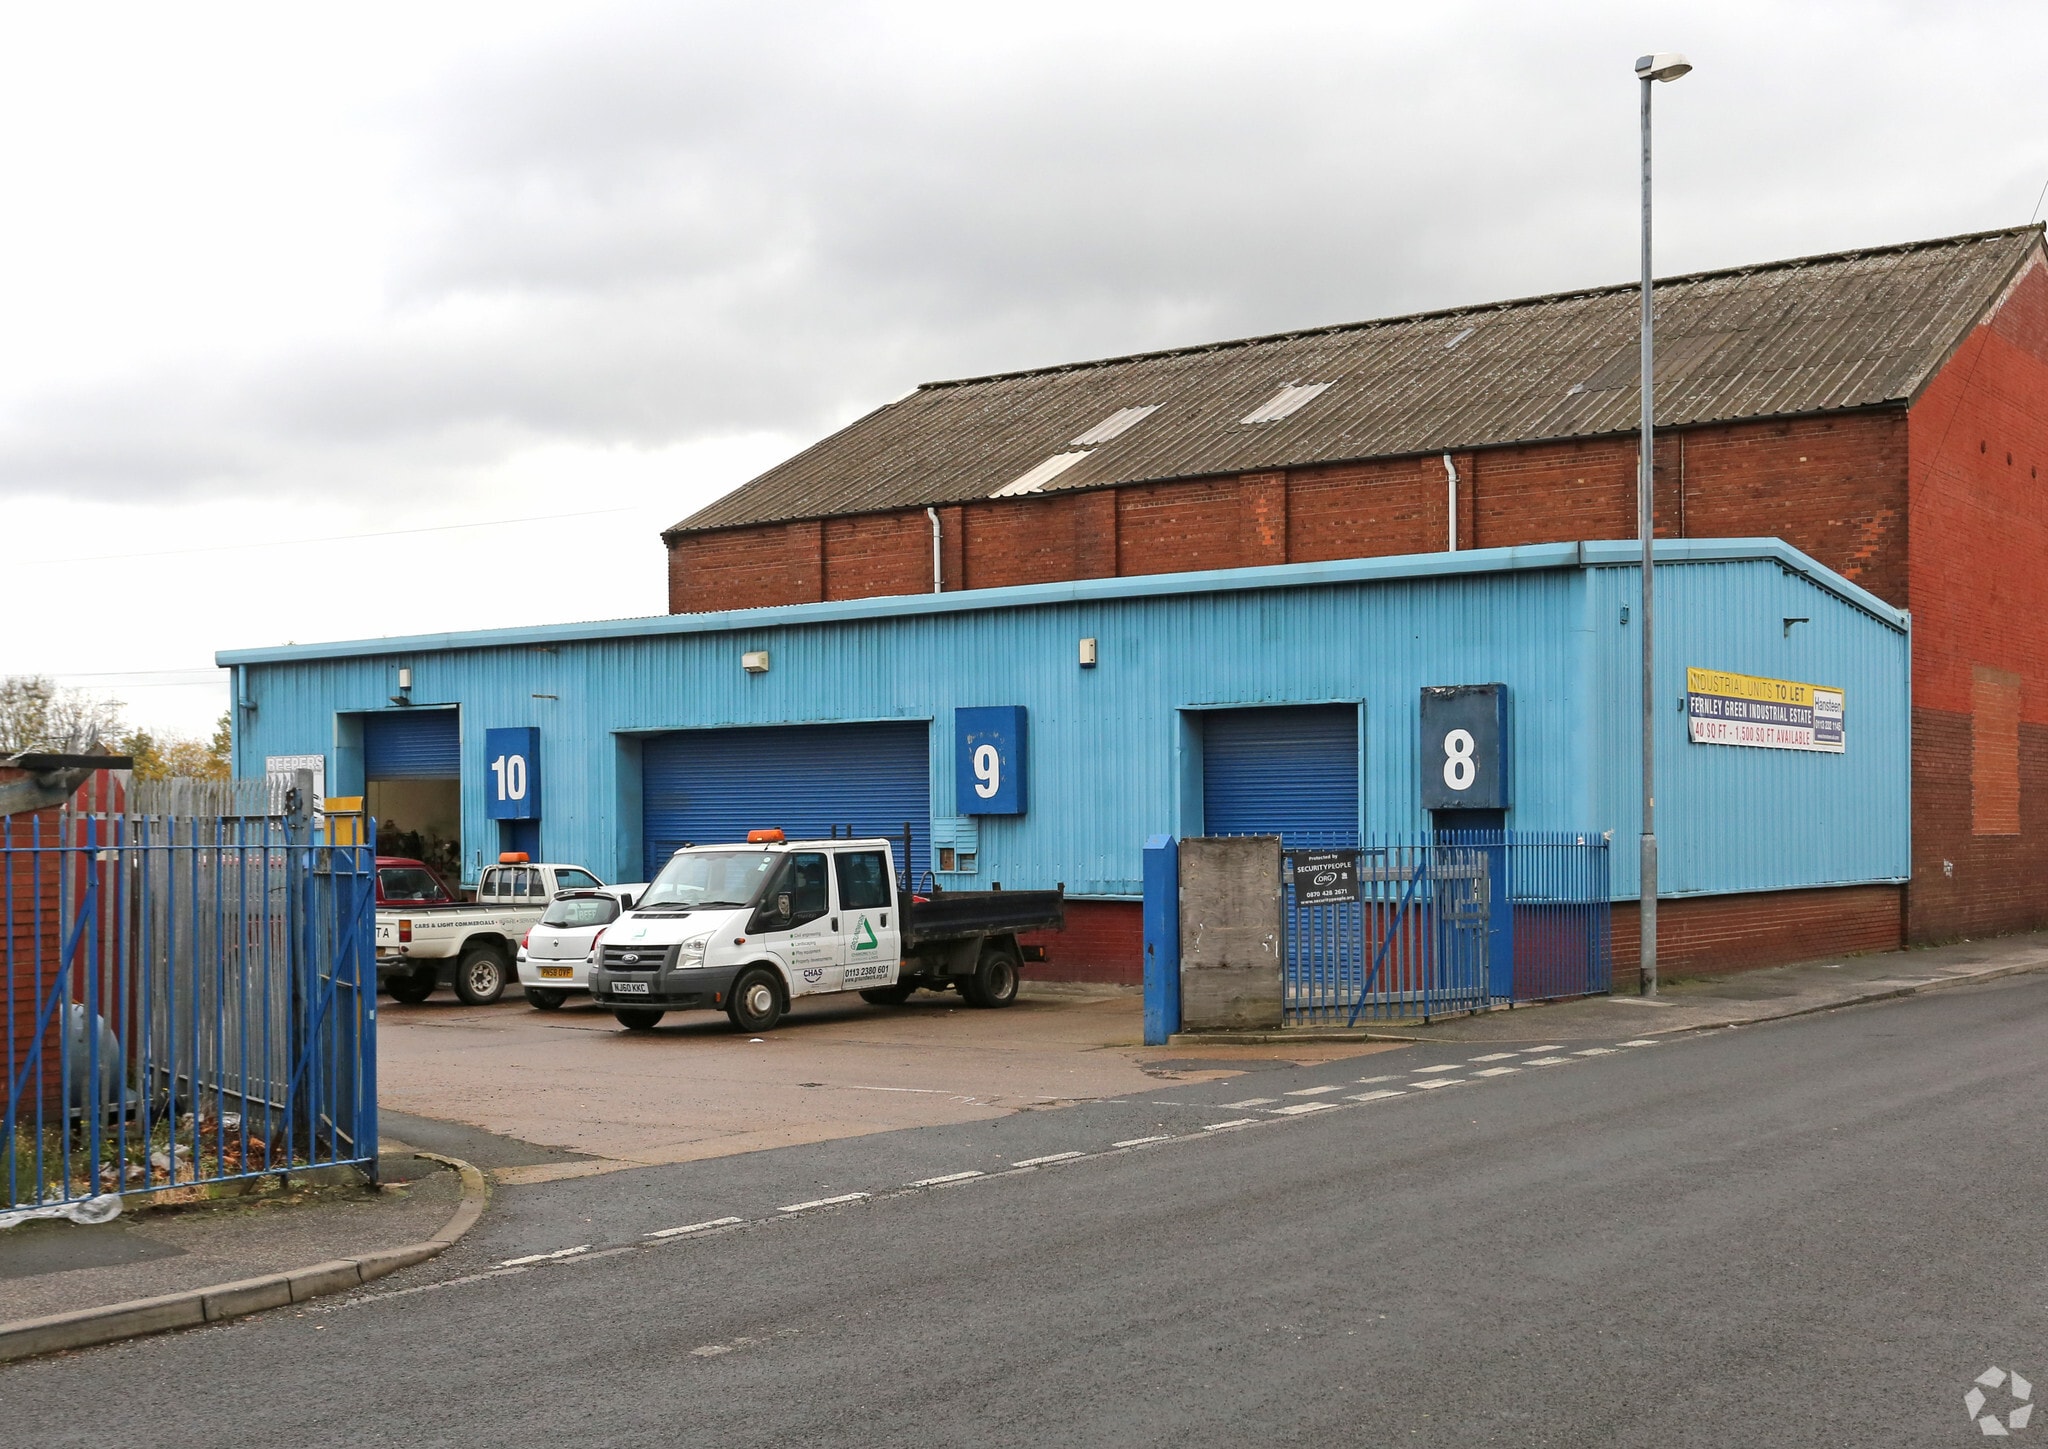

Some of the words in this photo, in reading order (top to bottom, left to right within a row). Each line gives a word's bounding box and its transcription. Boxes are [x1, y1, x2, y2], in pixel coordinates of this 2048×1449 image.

[1690, 673, 1744, 695] INDUSTRIAL
[1748, 681, 1772, 698] UNITS
[1776, 684, 1786, 700] TO
[1790, 686, 1804, 702] LET
[1690, 697, 1722, 715] FERNLEY
[1725, 701, 1747, 717] GREEN
[1749, 704, 1788, 721] INDUSTRIAL
[1790, 708, 1811, 724] ESTATE
[1815, 696, 1841, 713] Hansteen
[1707, 723, 1715, 739] SQ
[1719, 724, 1726, 739] FT
[1735, 726, 1753, 743] 1,500
[1756, 728, 1764, 743] SQ
[1767, 729, 1774, 743] FT
[1777, 730, 1810, 745] AVAILABLE
[267, 756, 323, 771] BEEPERS
[1443, 728, 1476, 791] 8
[491, 754, 526, 801] 10
[973, 744, 1000, 799] 9
[1297, 862, 1351, 873] SECURITYPEOPLE
[803, 968, 823, 977] CHAS
[845, 968, 860, 977] 0113
[861, 967, 876, 975] 2380
[878, 965, 888, 974] 601
[614, 983, 631, 992] NJ60
[632, 984, 646, 992] KKC
